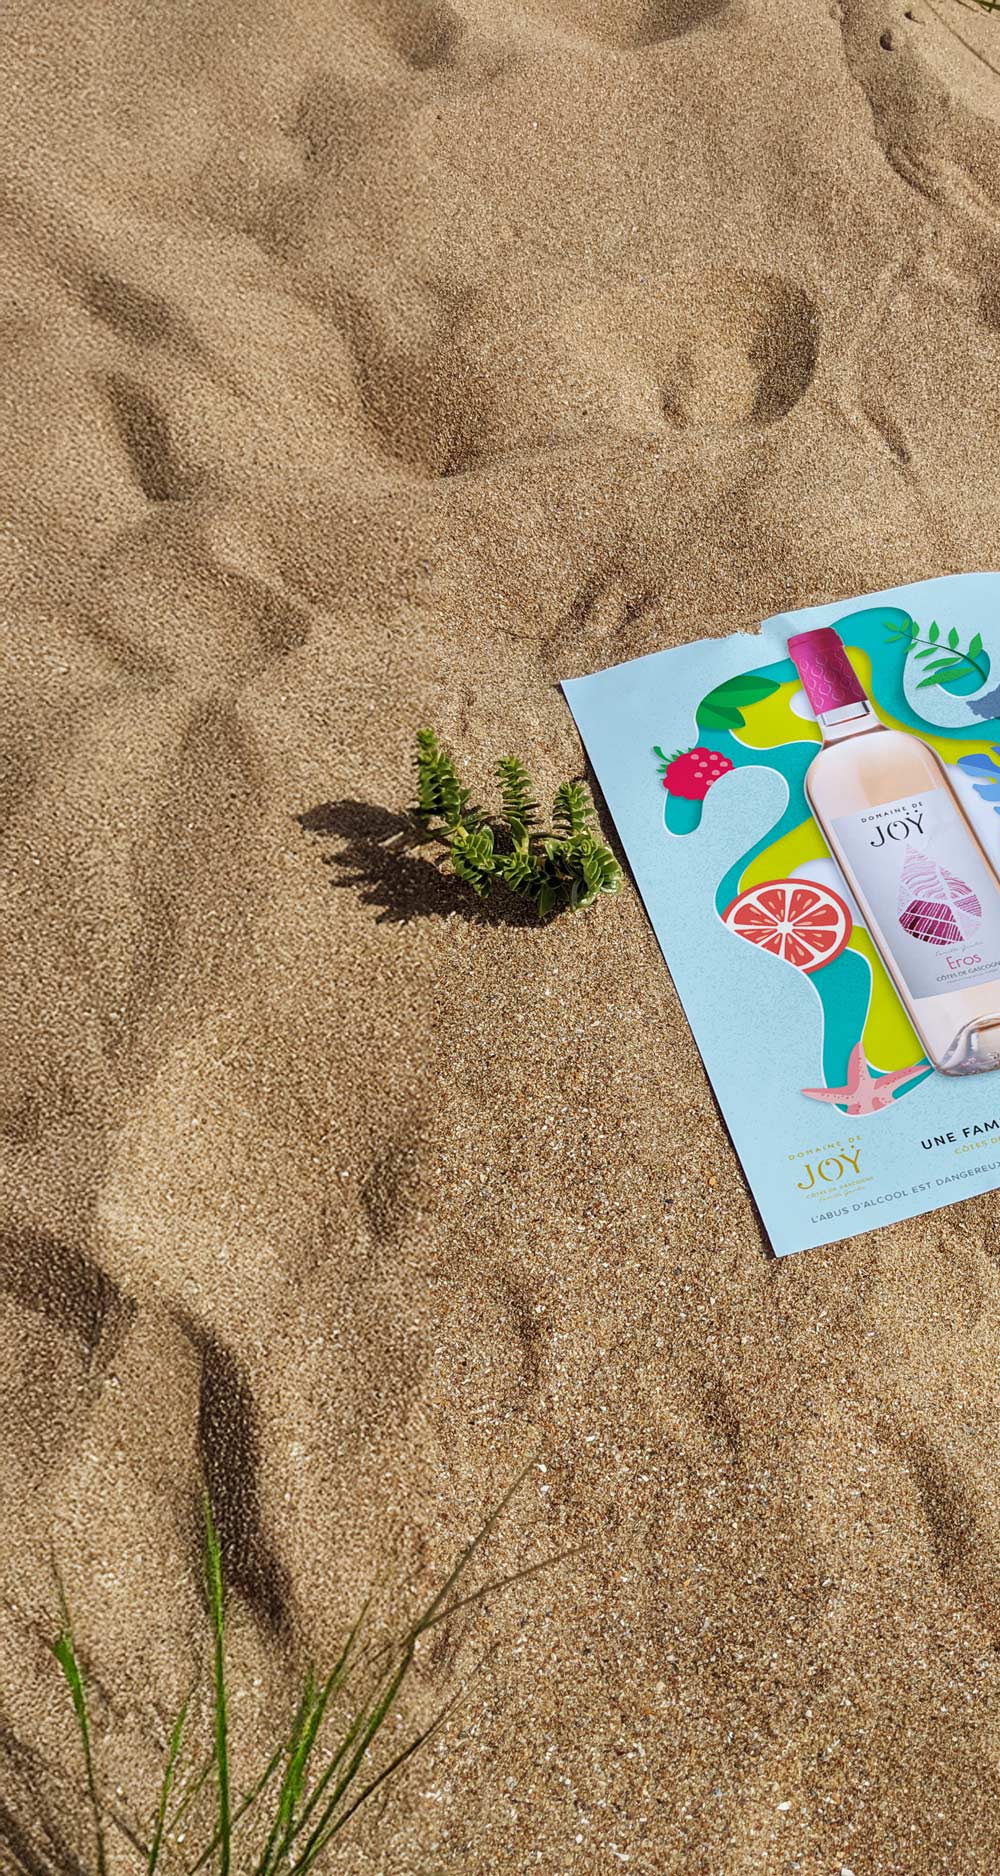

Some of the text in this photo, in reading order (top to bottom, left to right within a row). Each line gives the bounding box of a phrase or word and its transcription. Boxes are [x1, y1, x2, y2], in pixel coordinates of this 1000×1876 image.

[861, 806, 907, 823] DOMAINE
[870, 810, 924, 847] JOŸ
[945, 954, 982, 970] Eros
[788, 1135, 862, 1161] DOMAINE DE
[920, 1132, 957, 1150] UNE
[797, 1144, 862, 1190] JOŸ
[811, 1206, 850, 1224] L'ABUS
[852, 1190, 909, 1212] D'ALCOOL
[911, 1182, 932, 1194] EST
